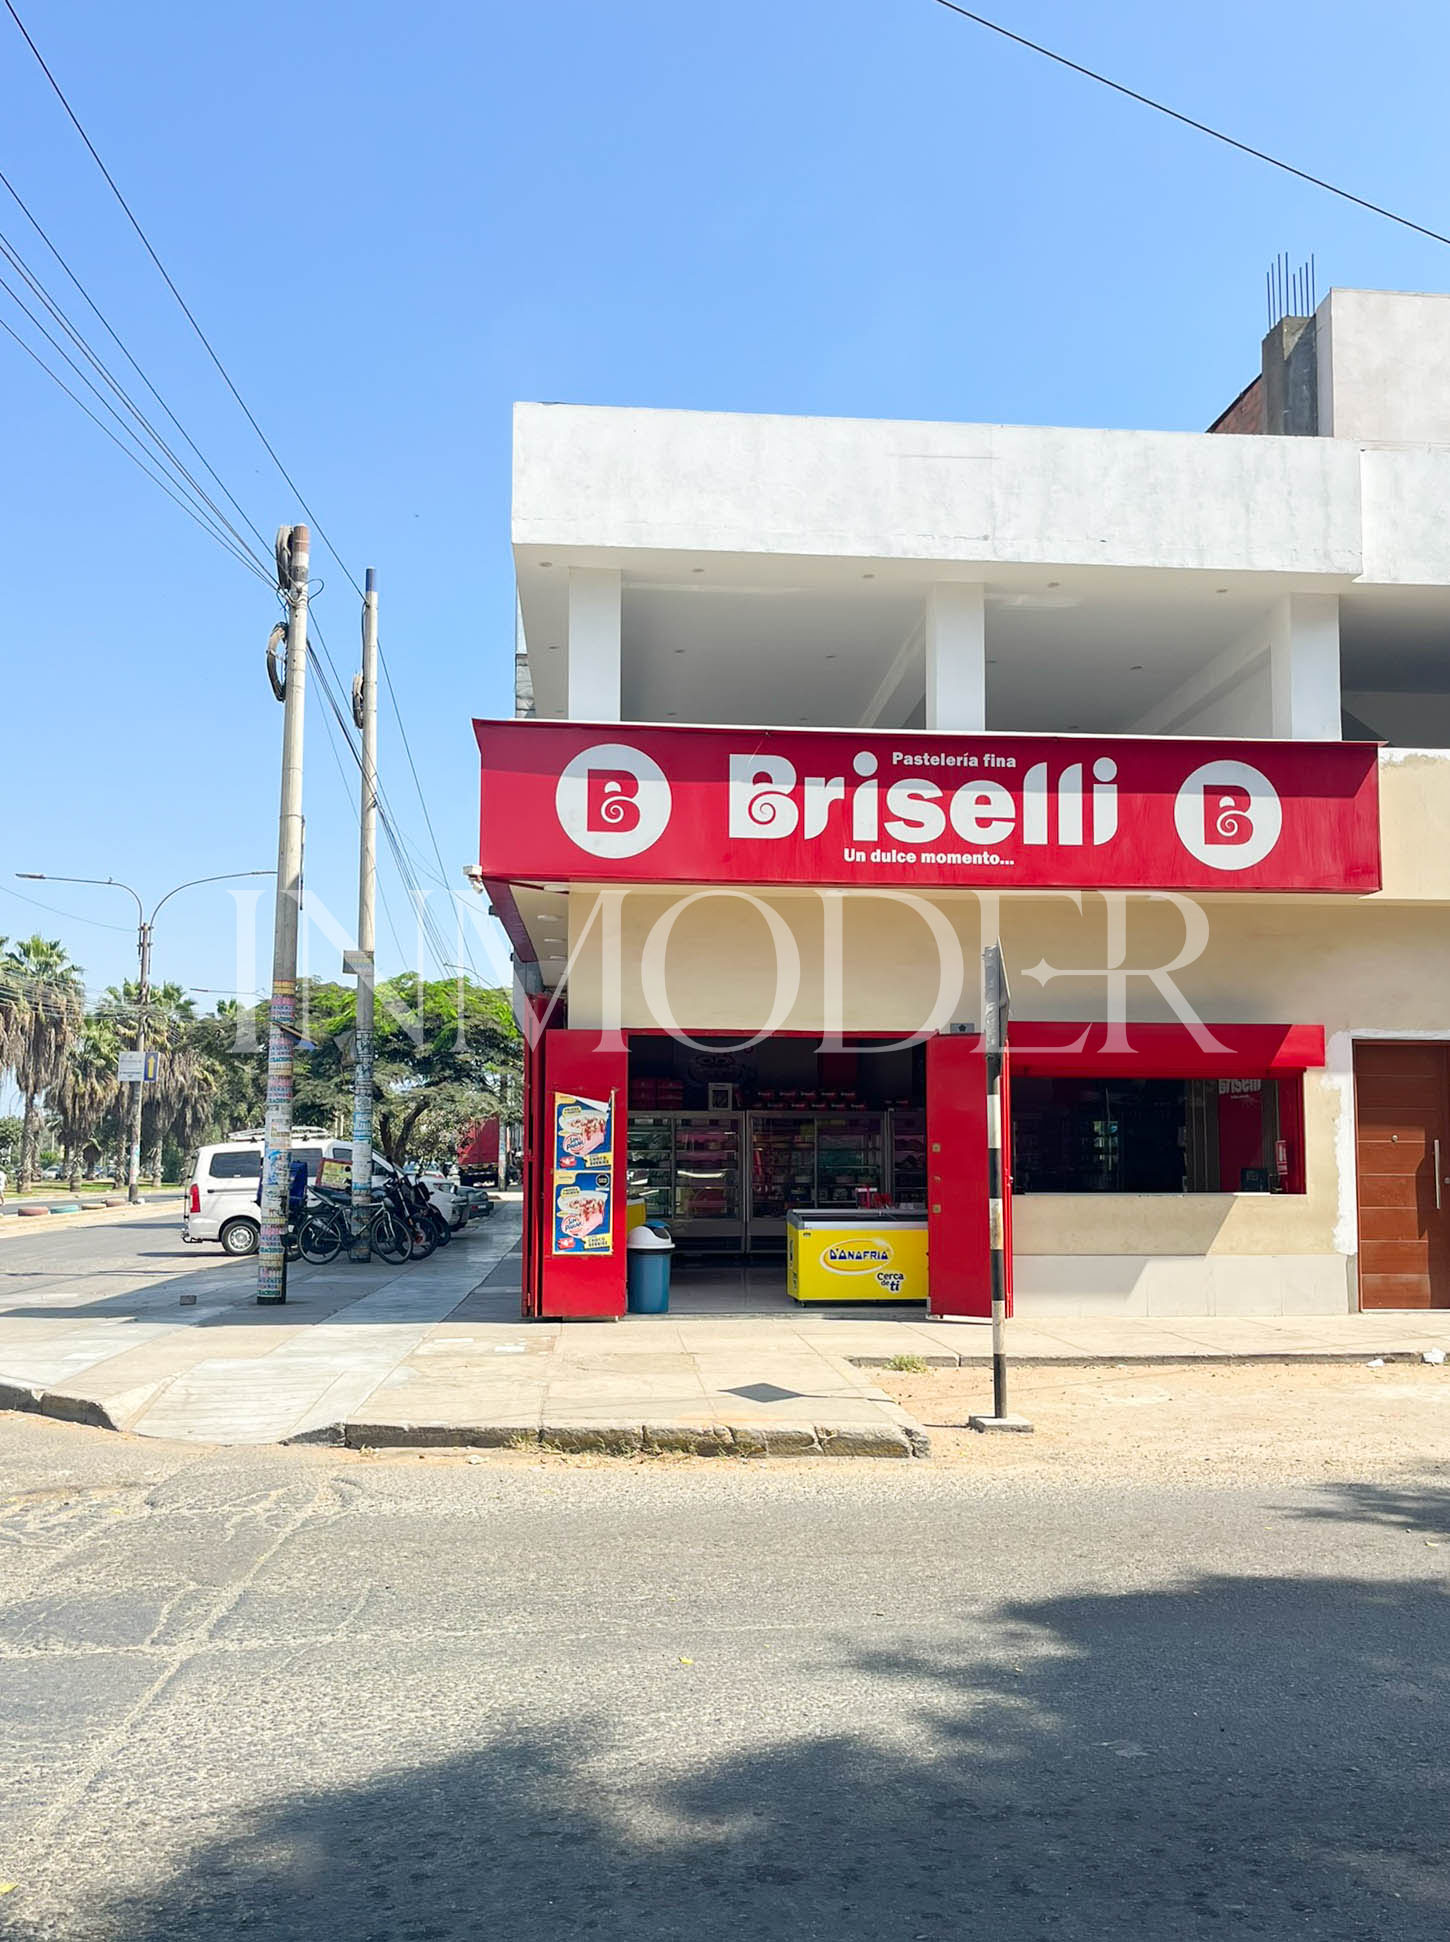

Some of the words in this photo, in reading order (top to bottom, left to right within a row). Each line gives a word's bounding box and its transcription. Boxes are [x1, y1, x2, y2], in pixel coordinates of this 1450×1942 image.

[892, 751, 978, 768] Pastelería
[982, 753, 1016, 768] fina
[587, 768, 641, 833] B
[729, 751, 1119, 846] Briselli
[1203, 784, 1254, 846] B
[843, 848, 867, 863] Un
[870, 849, 917, 864] dulce
[920, 851, 1015, 866] momento...
[876, 1272, 905, 1281] Cerca
[890, 1280, 900, 1291] ti
